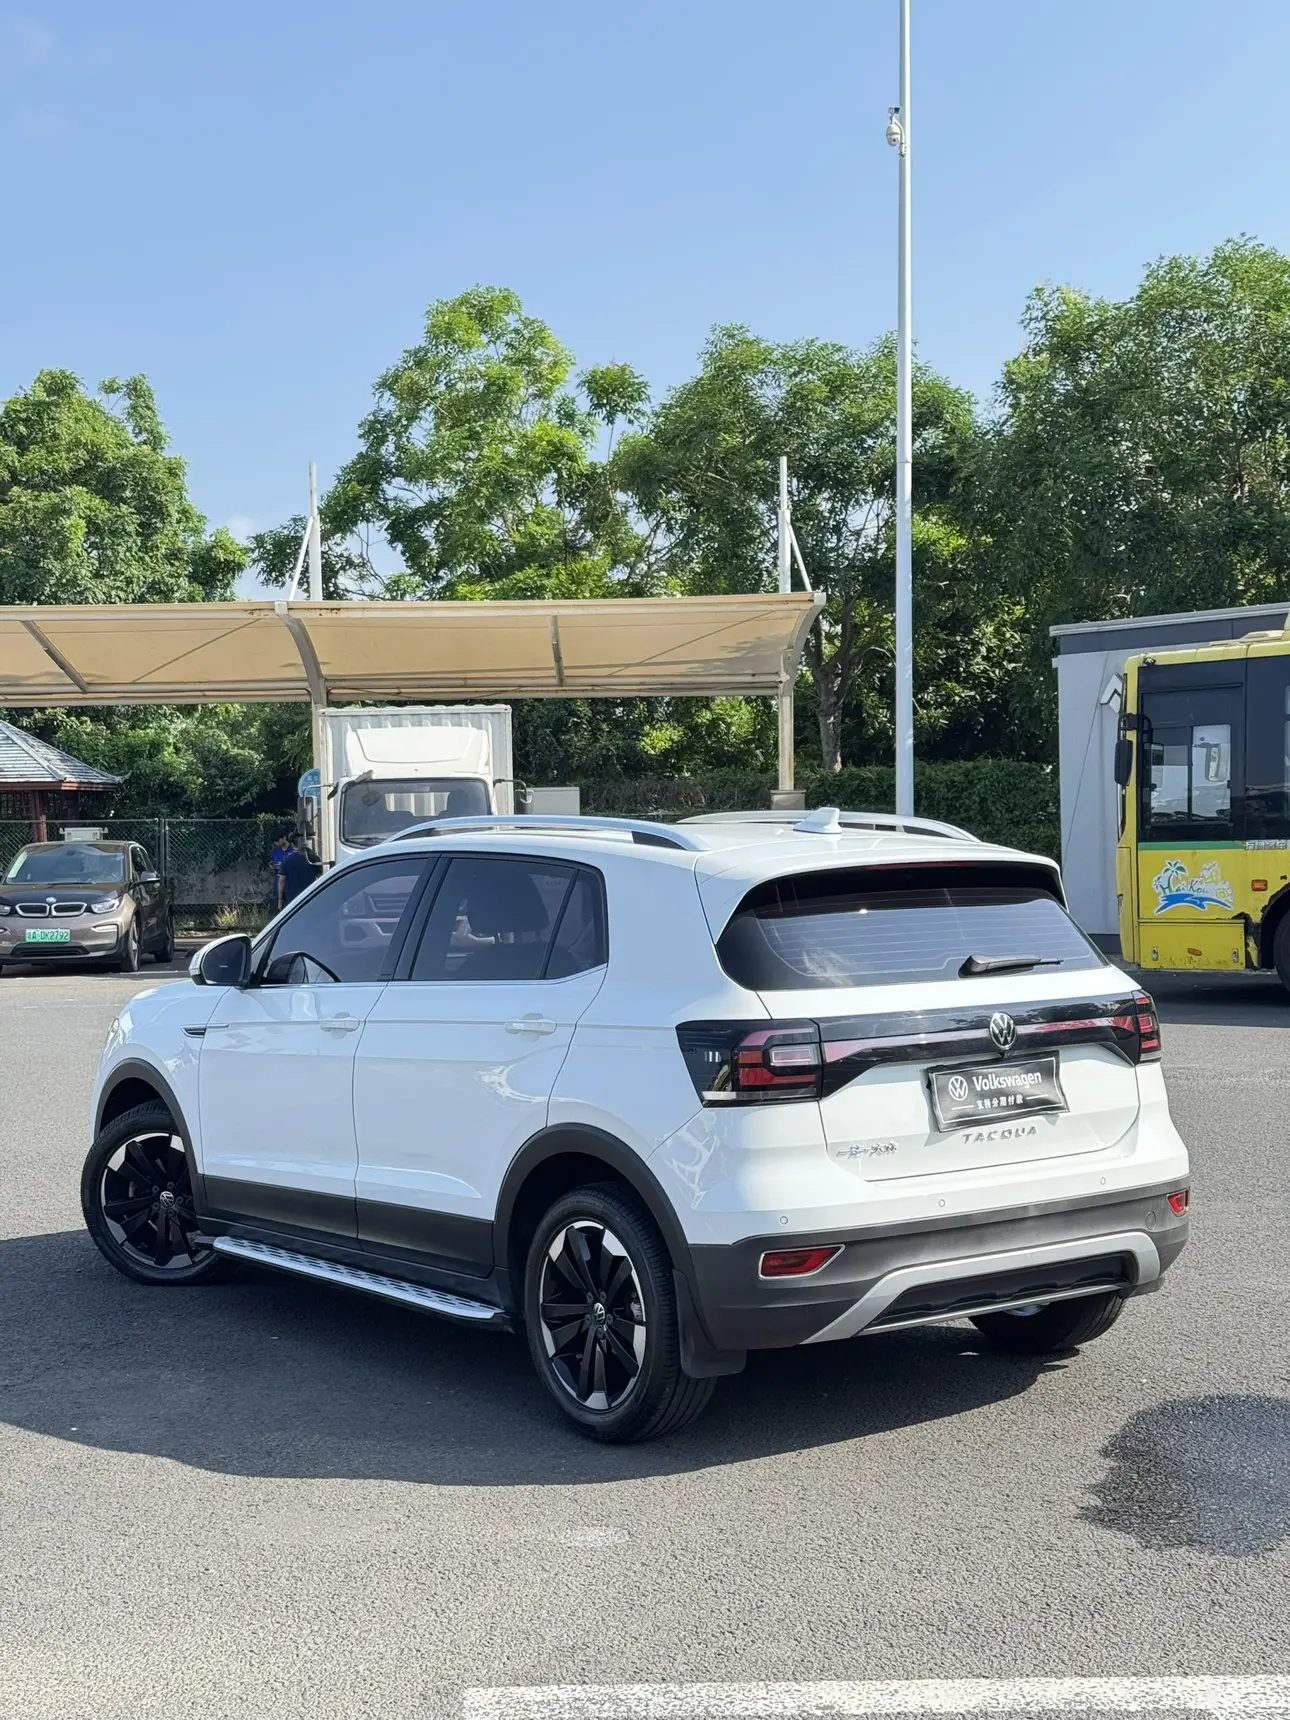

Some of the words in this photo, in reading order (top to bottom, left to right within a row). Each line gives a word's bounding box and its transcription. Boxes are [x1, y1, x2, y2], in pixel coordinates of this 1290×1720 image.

[972, 1072, 1042, 1092] Volkswagen
[976, 1094, 1024, 1110] 支持分期付款
